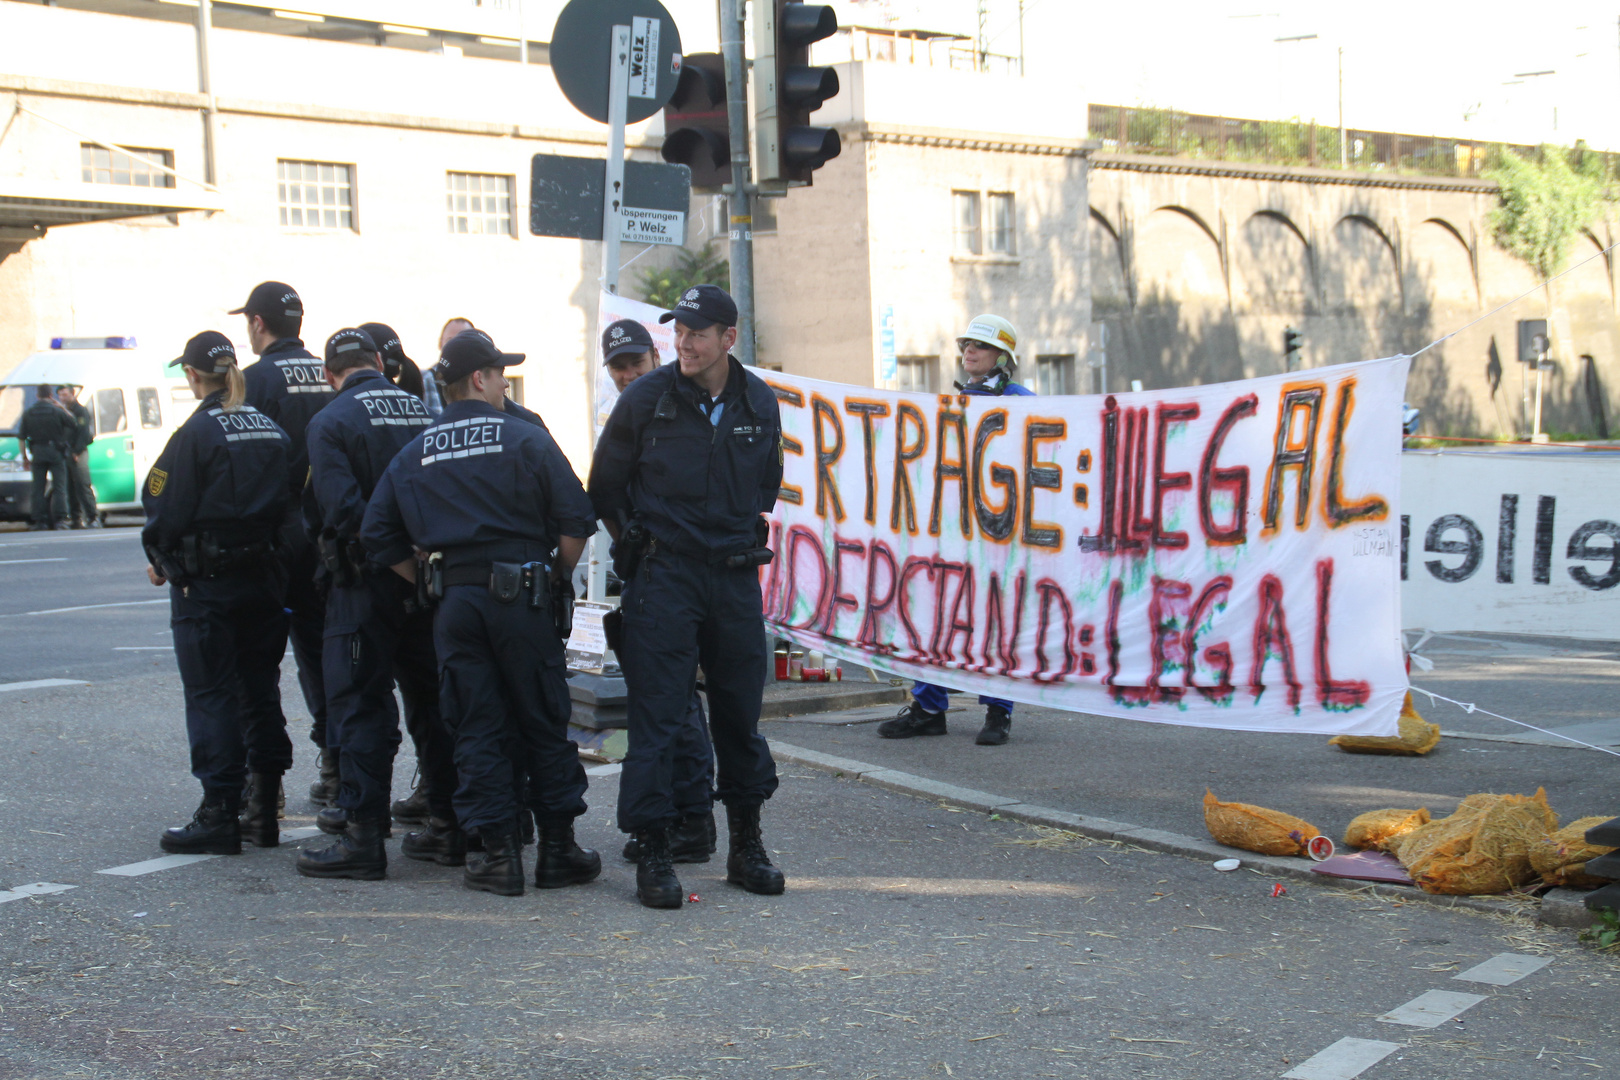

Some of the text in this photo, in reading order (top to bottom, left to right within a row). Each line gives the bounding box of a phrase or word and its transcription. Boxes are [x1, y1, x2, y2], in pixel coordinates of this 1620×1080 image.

[631, 36, 645, 77] Welz
[627, 219, 667, 234] P. Welz
[207, 345, 235, 357] POLIZE
[608, 336, 632, 348] POLIZEI
[281, 366, 328, 384] POLIZ
[362, 398, 429, 416] POLIZEI
[216, 413, 276, 432] POLIZEI
[423, 425, 500, 455] POLIZEI
[764, 379, 1093, 553] ERTRÄGE:
[760, 520, 1371, 708] IDERSTAND: LEGAL
